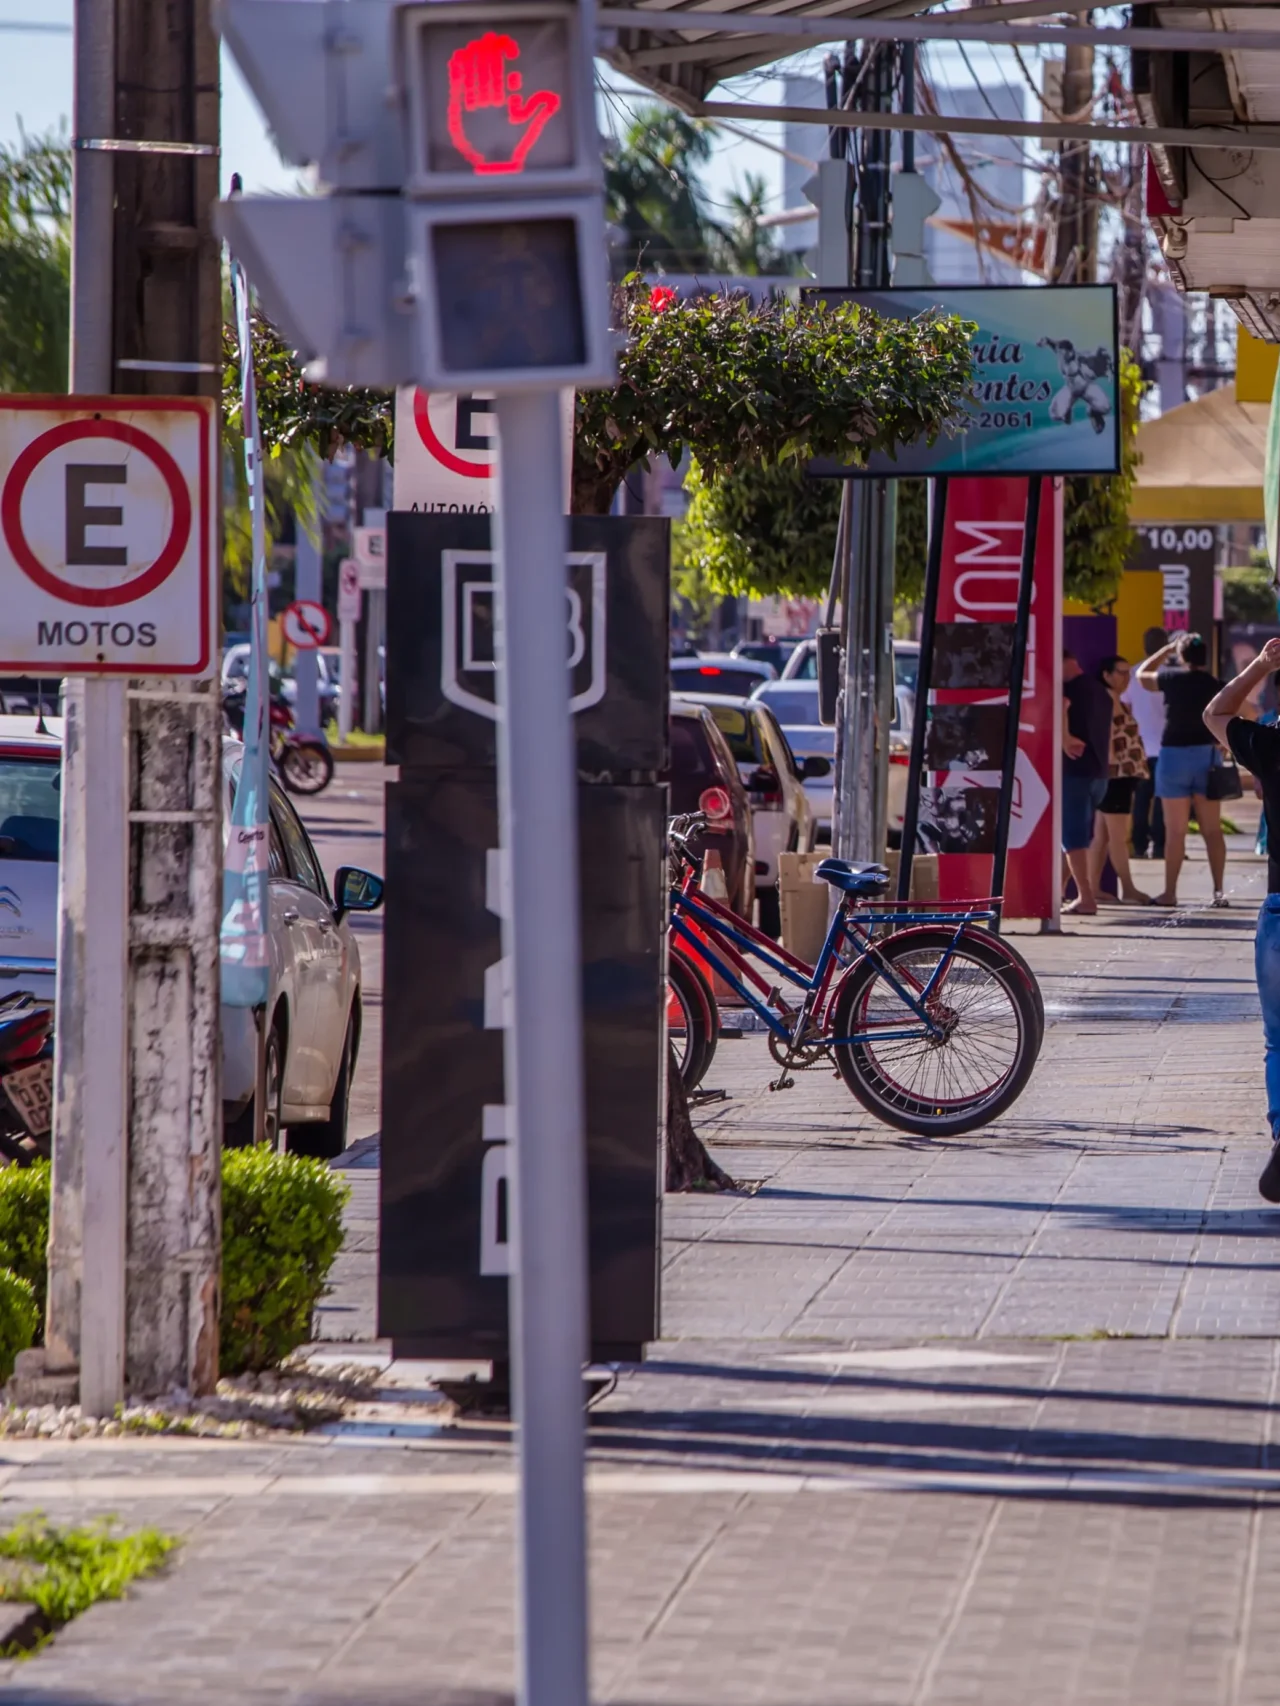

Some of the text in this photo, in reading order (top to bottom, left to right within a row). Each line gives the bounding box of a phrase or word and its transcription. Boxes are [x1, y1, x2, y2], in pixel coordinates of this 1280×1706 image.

[65, 464, 128, 566] E
[1148, 527, 1214, 555] 10,00
[37, 620, 157, 647] MOTOS
